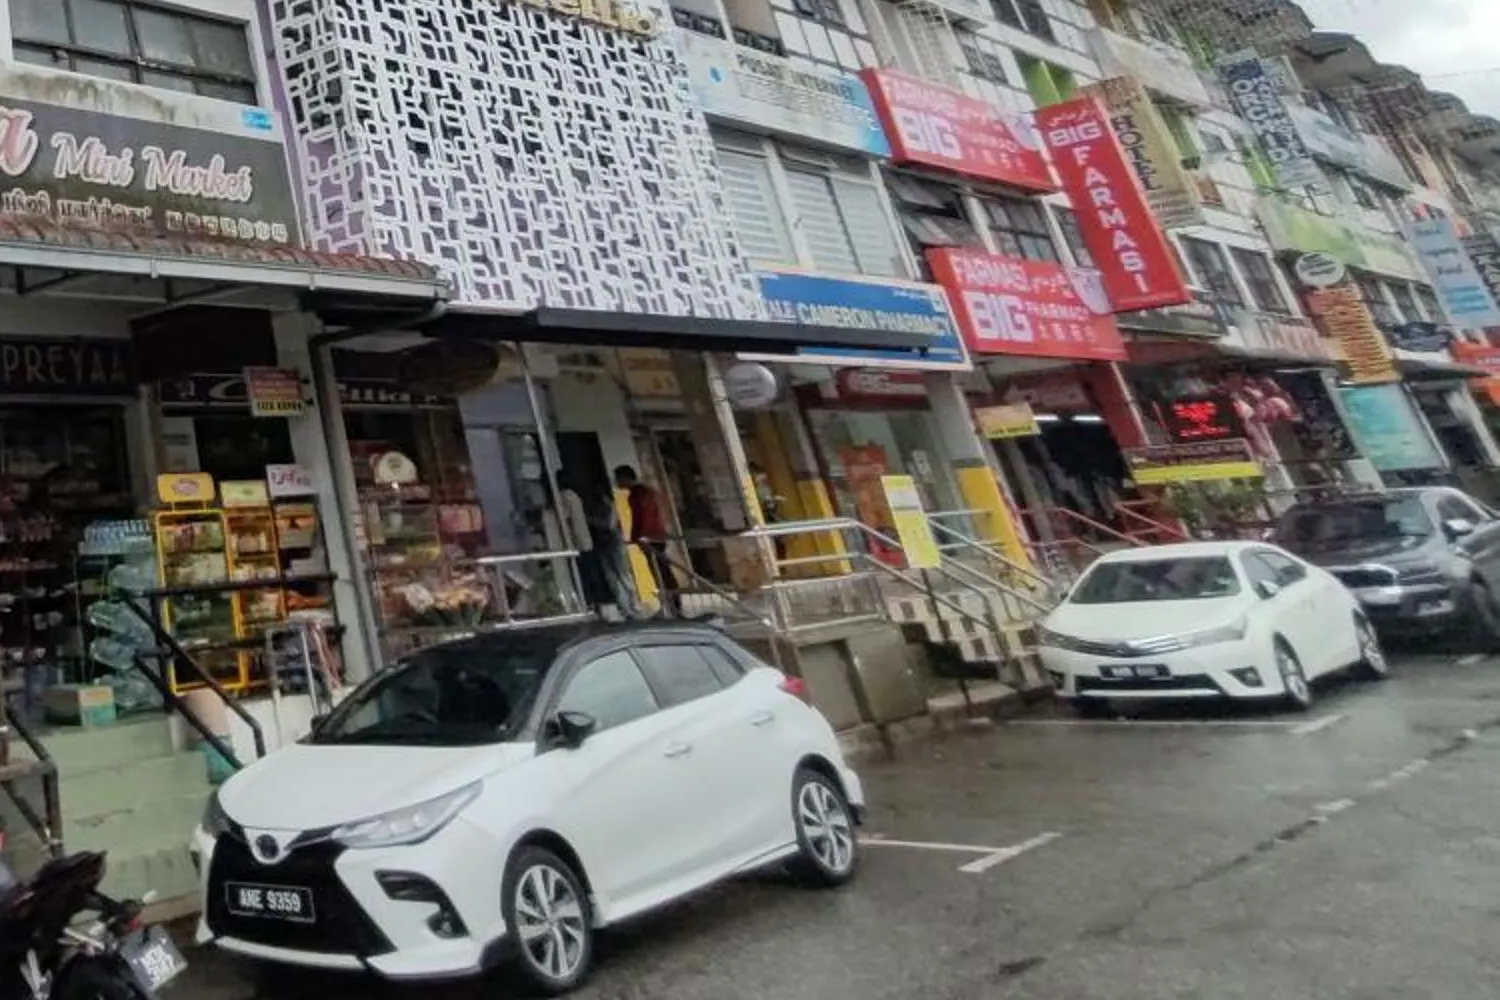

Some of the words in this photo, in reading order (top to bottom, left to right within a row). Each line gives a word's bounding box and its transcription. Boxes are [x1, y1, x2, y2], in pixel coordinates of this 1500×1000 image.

[893, 107, 963, 160] BIG
[1048, 121, 1103, 148] BIG
[51, 130, 135, 188] Mini
[141, 144, 254, 203] Market
[1071, 144, 1150, 294] FARMASI
[796, 301, 875, 330] CAMERON
[961, 290, 1034, 343] BIG
[3, 343, 126, 385] PREYAA
